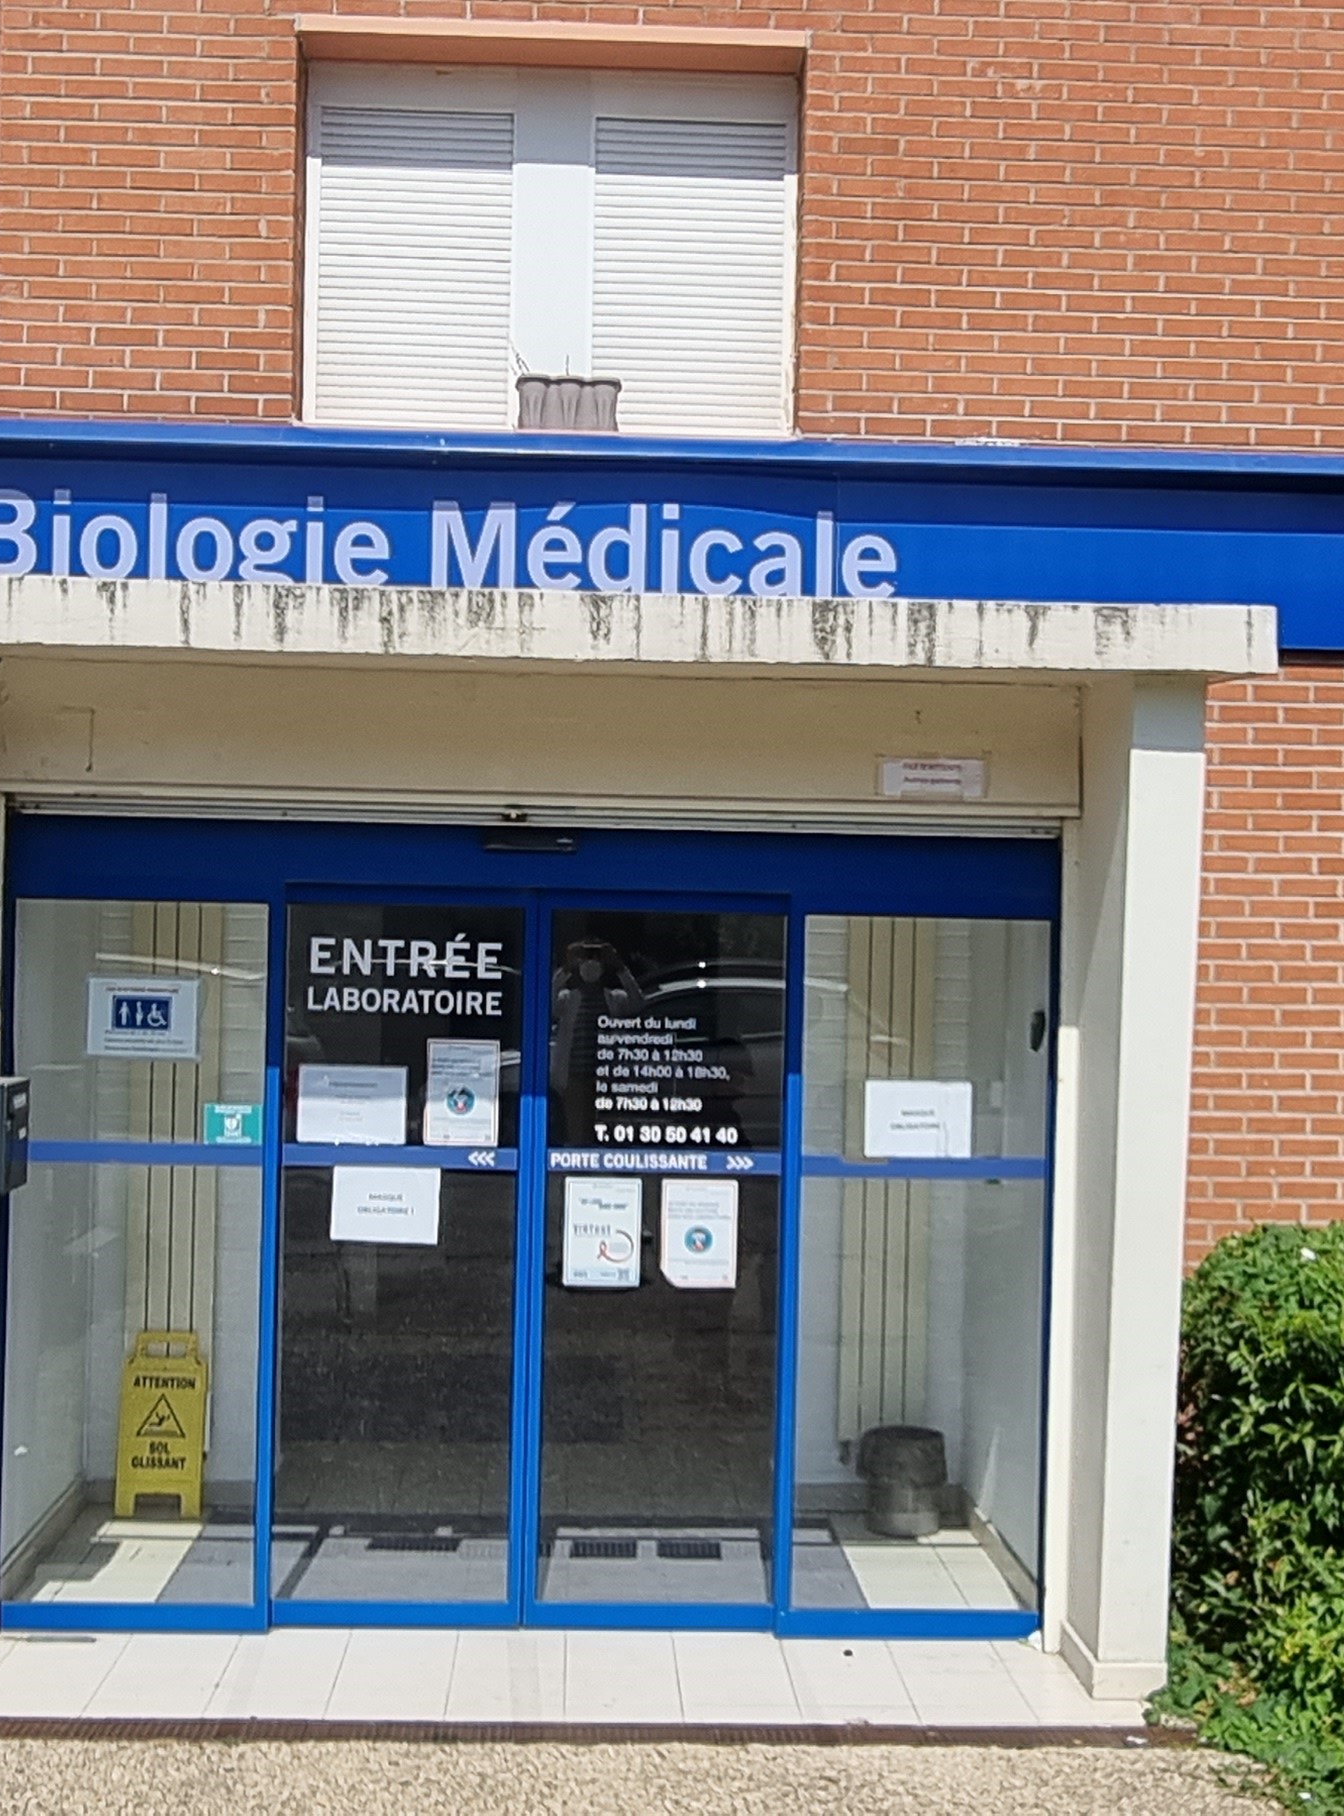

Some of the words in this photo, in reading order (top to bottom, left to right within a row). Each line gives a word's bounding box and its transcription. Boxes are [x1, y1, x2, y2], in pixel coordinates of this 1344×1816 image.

[429, 499, 898, 599] Médicale
[309, 932, 504, 980] ENTRÉE
[307, 985, 503, 1017] LABORATOIRE
[597, 1015, 642, 1030] Ouvert
[644, 1016, 662, 1030] du
[664, 1016, 697, 1030] lundi
[597, 1048, 615, 1061] de
[618, 1048, 649, 1061] 7h30
[651, 1048, 661, 1062] à
[663, 1049, 704, 1063] 12h30
[596, 1064, 609, 1078] et
[612, 1064, 630, 1078] de
[633, 1065, 672, 1078] 14h00
[675, 1065, 684, 1079] à
[596, 1080, 608, 1093] le
[611, 1081, 659, 1094] samedi
[594, 1096, 614, 1111] de
[616, 1096, 649, 1111] 7h30
[662, 1097, 704, 1112] 12h30
[594, 1124, 610, 1143] T.
[613, 1124, 635, 1143] 01
[639, 1125, 662, 1143] 30
[665, 1125, 687, 1143] 50
[690, 1126, 711, 1143] 41
[715, 1126, 739, 1145] 40
[550, 1152, 600, 1169] PORTE
[603, 1153, 708, 1170] COULISSANTE
[133, 1375, 197, 1390] ATTENTION
[149, 1440, 171, 1455] SOL
[131, 1457, 187, 1471] GLISSANT
